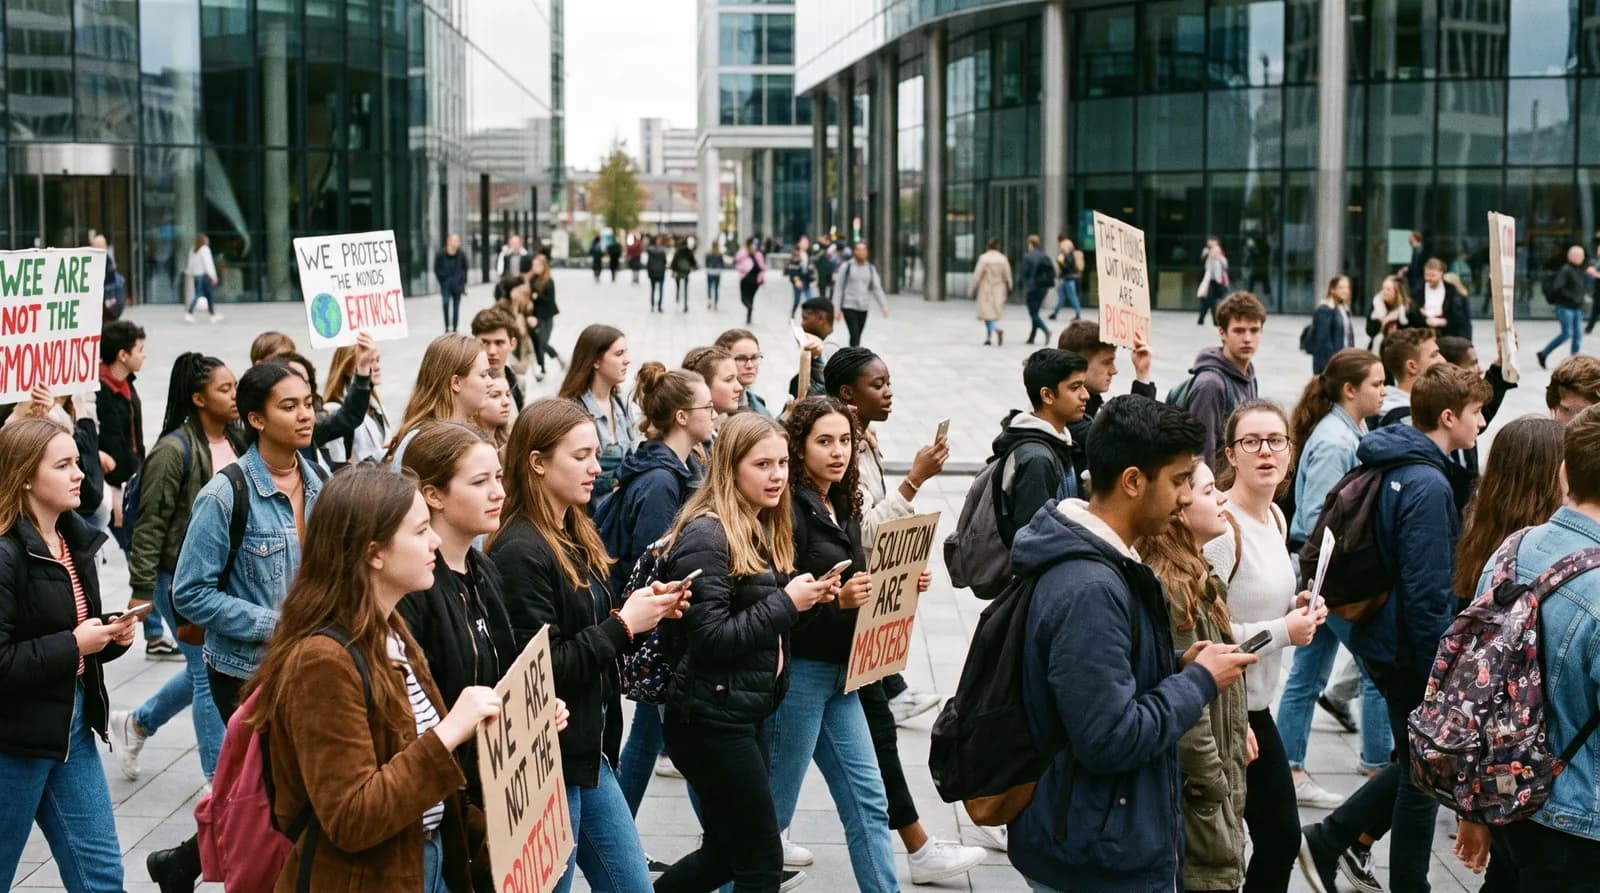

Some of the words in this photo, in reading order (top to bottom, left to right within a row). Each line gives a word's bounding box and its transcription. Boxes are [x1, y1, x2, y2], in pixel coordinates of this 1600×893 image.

[300, 244, 333, 271] WE
[341, 240, 393, 267] PROTEST
[1097, 220, 1116, 252] THE
[0, 257, 45, 297] WEE
[54, 256, 92, 294] ARE
[1119, 286, 1134, 308] ARE
[2, 303, 42, 336] NOT
[46, 300, 80, 331] THE
[870, 523, 937, 574] SOLUTION
[872, 573, 908, 618] ARE
[849, 615, 915, 679] MASTERS
[484, 689, 516, 780] WE
[524, 647, 548, 731] ARE
[505, 756, 530, 837] NOT
[531, 719, 554, 790] THE
